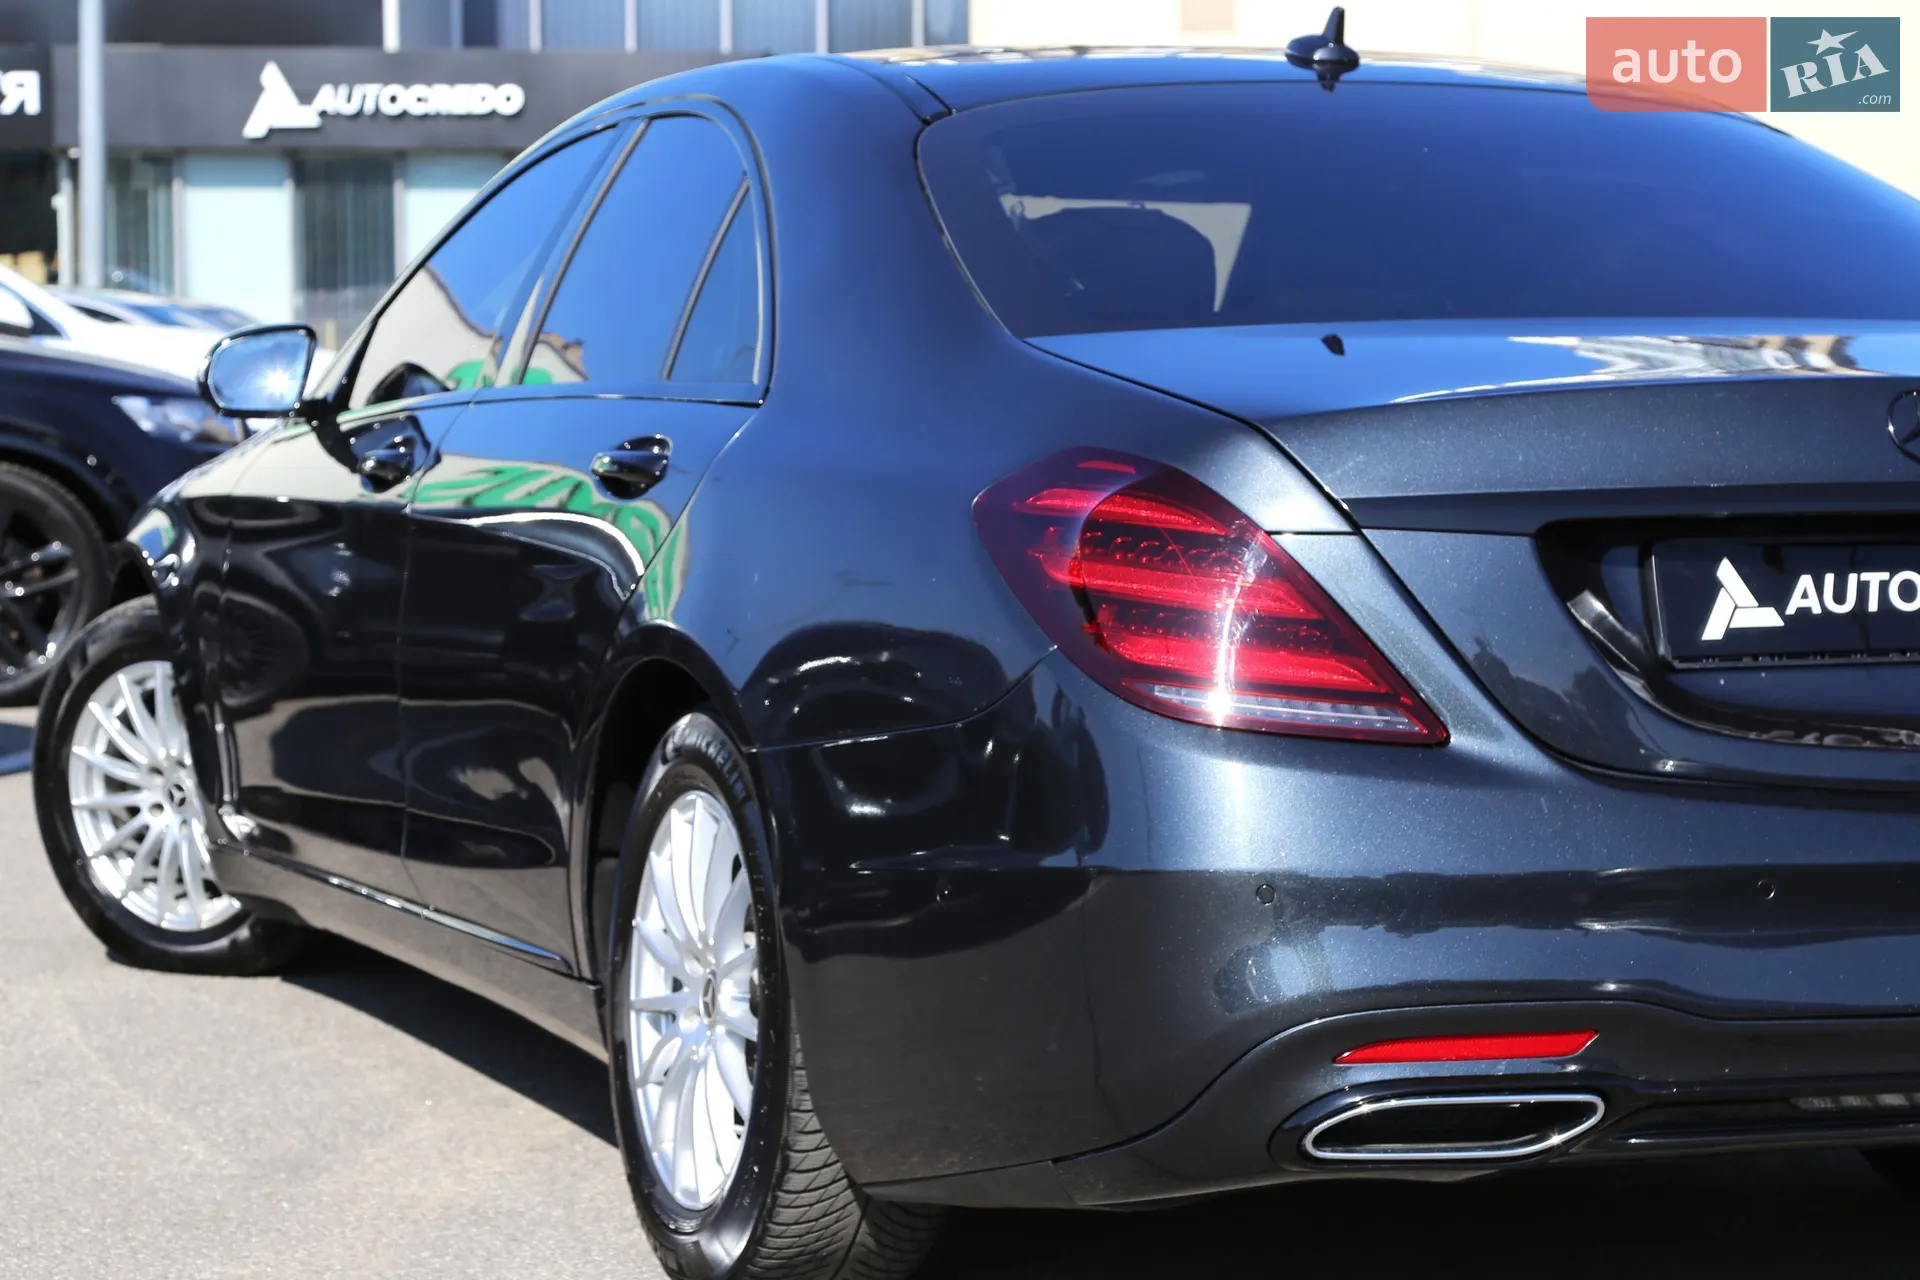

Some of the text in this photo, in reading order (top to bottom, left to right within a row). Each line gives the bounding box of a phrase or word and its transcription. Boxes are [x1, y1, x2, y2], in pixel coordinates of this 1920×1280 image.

[0, 69, 41, 116] Я
[311, 83, 526, 117] AUTOCREDO
[1785, 570, 1920, 616] AUTO
